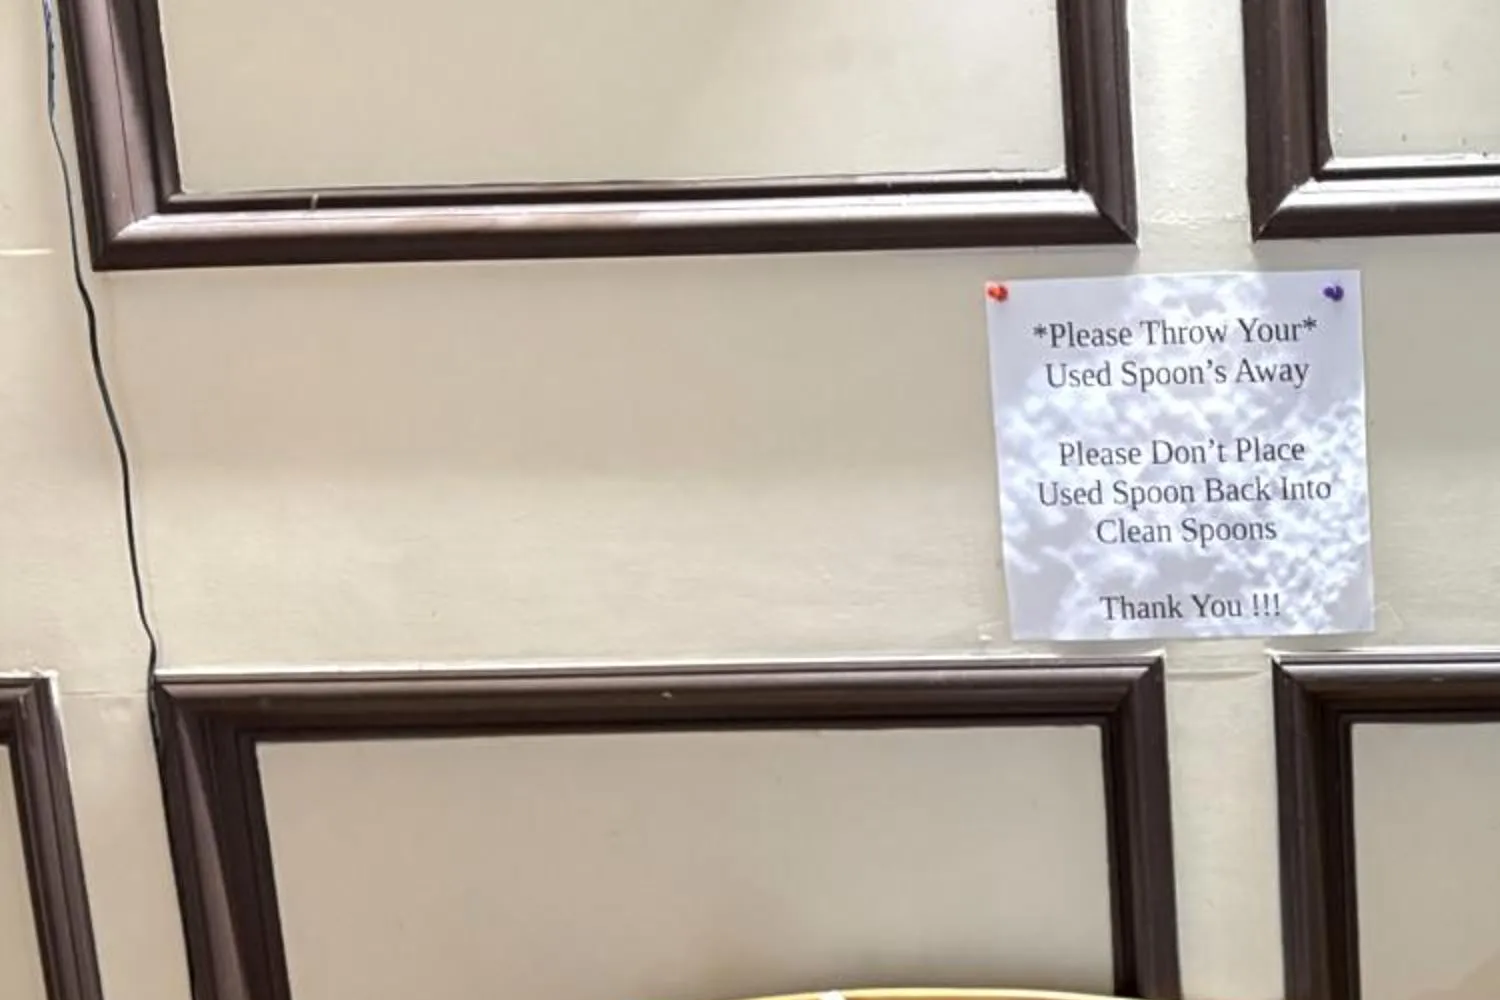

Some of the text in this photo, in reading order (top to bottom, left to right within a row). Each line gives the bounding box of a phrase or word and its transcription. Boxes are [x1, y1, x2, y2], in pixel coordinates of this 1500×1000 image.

[1140, 320, 1227, 345] Throw
[1045, 358, 1310, 392] Used Spoon's Away
[1059, 437, 1306, 466] Please Don't Place
[1038, 476, 1332, 510] Used Spoon Back Into
[1096, 517, 1278, 548] Clean Spoons
[1100, 594, 1184, 621] Thank
[1192, 594, 1243, 619] You
